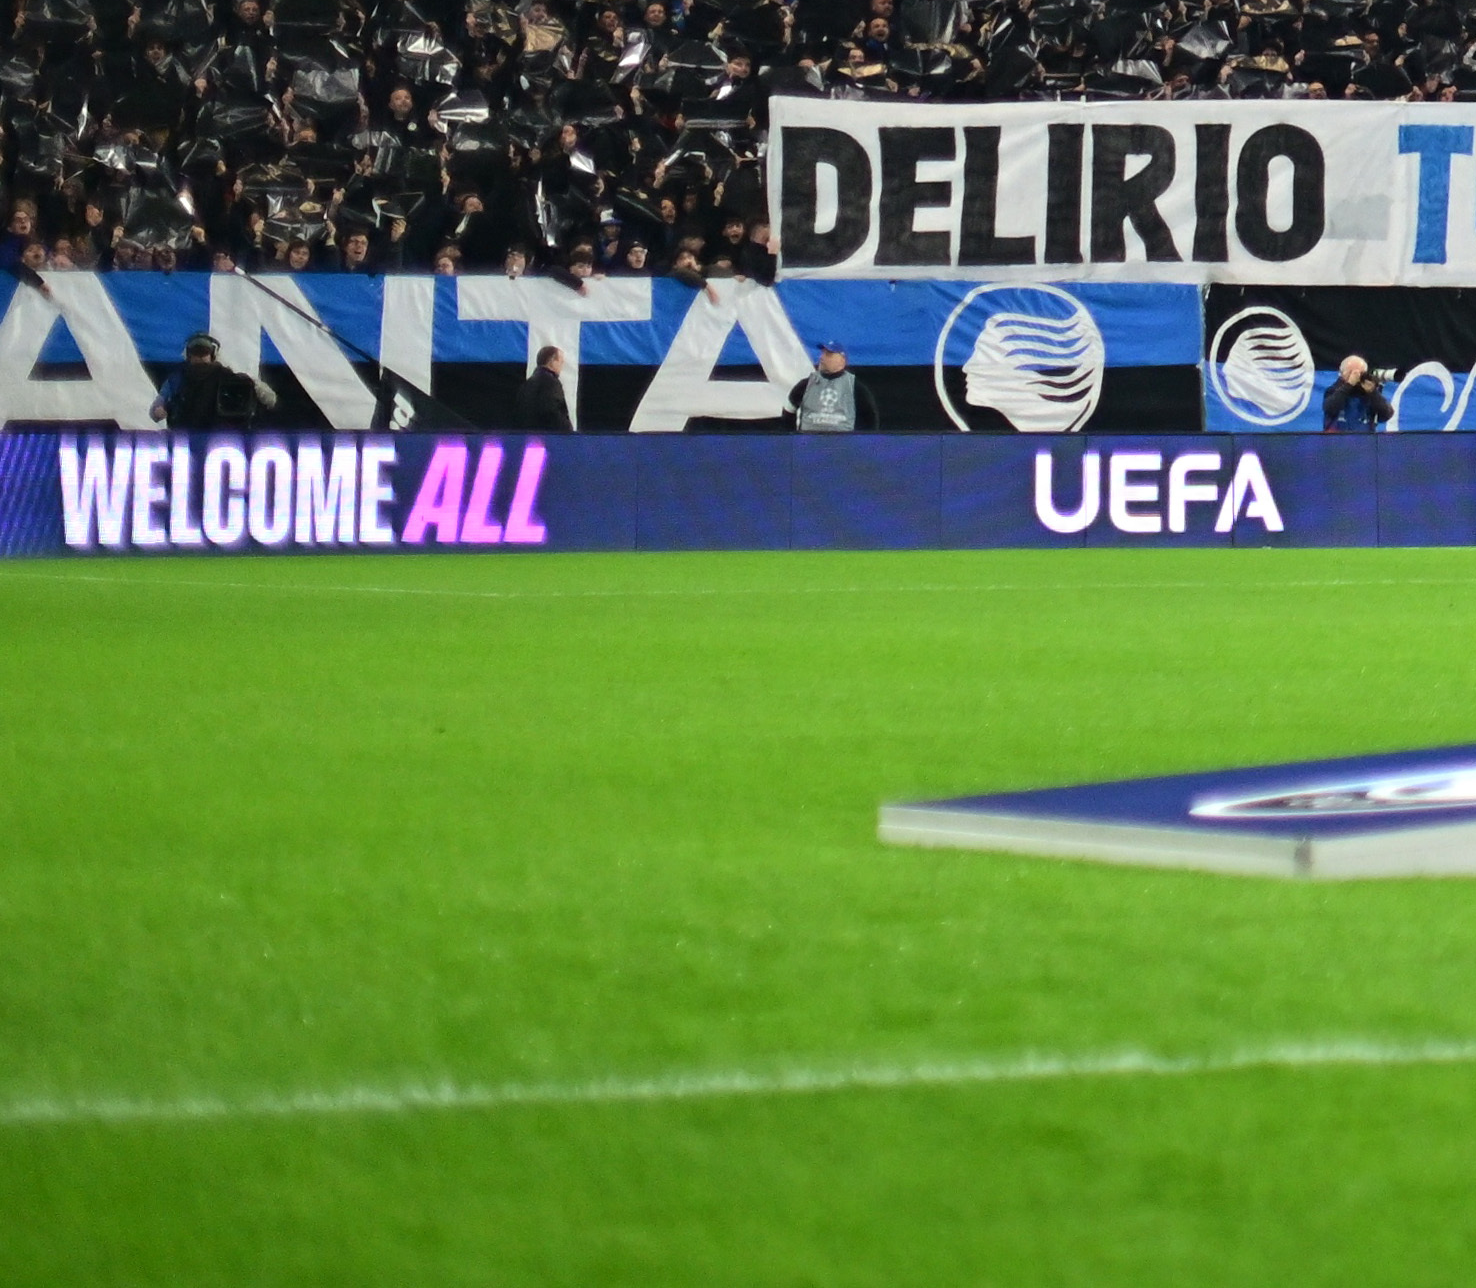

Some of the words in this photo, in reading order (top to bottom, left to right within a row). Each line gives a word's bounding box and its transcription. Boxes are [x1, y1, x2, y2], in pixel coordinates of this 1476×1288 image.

[781, 123, 1325, 267] DELIRIO
[60, 439, 396, 546] WELCOME
[402, 439, 548, 546] ALL
[1034, 451, 1285, 533] UEFA
